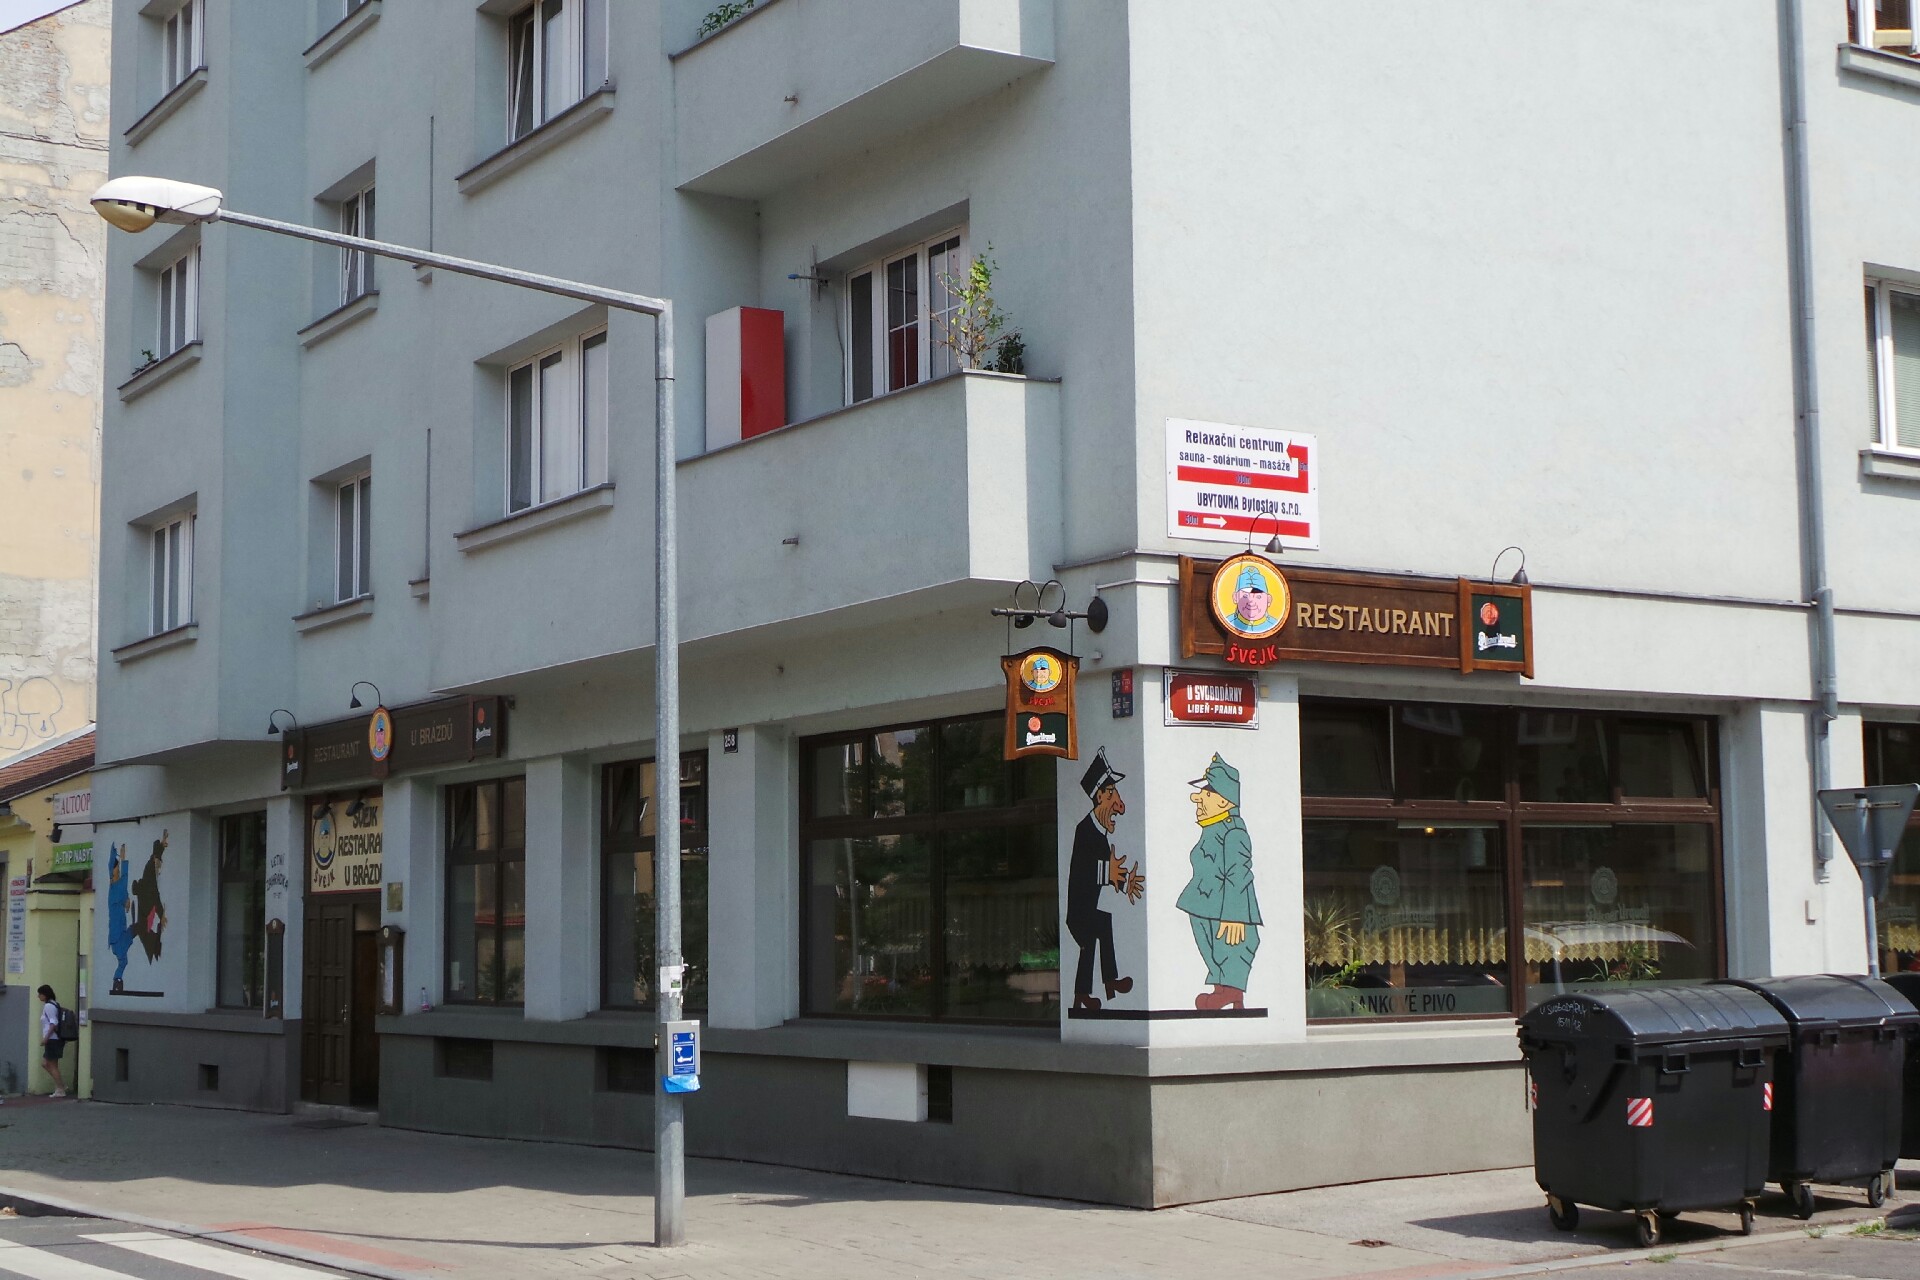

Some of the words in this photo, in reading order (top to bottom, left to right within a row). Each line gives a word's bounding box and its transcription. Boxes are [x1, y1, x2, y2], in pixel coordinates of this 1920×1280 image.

[1185, 430, 1236, 448] Relaxační
[1239, 437, 1284, 453] centrum
[1179, 451, 1205, 463] sauna
[1213, 453, 1251, 468] solárium
[1259, 459, 1291, 472] masáže
[1197, 492, 1239, 511] UBYTOVNA
[1241, 497, 1279, 514] Bytoslav
[1281, 503, 1302, 516] s.r.o.
[1296, 602, 1454, 637] RESTAURANT
[1226, 643, 1278, 665] ŠVEJK
[1187, 684, 1193, 700] U
[1194, 684, 1243, 703] SVOBODÁRNY
[1187, 702, 1210, 714] LIBEŇ
[1214, 705, 1237, 715] PRAHA
[1237, 706, 1243, 715] 9
[411, 729, 417, 746] U
[420, 717, 453, 745] BRÁZDŮ
[313, 740, 361, 763] RESTAURANT
[344, 865, 350, 886] U
[1423, 993, 1456, 1012] PIVO
